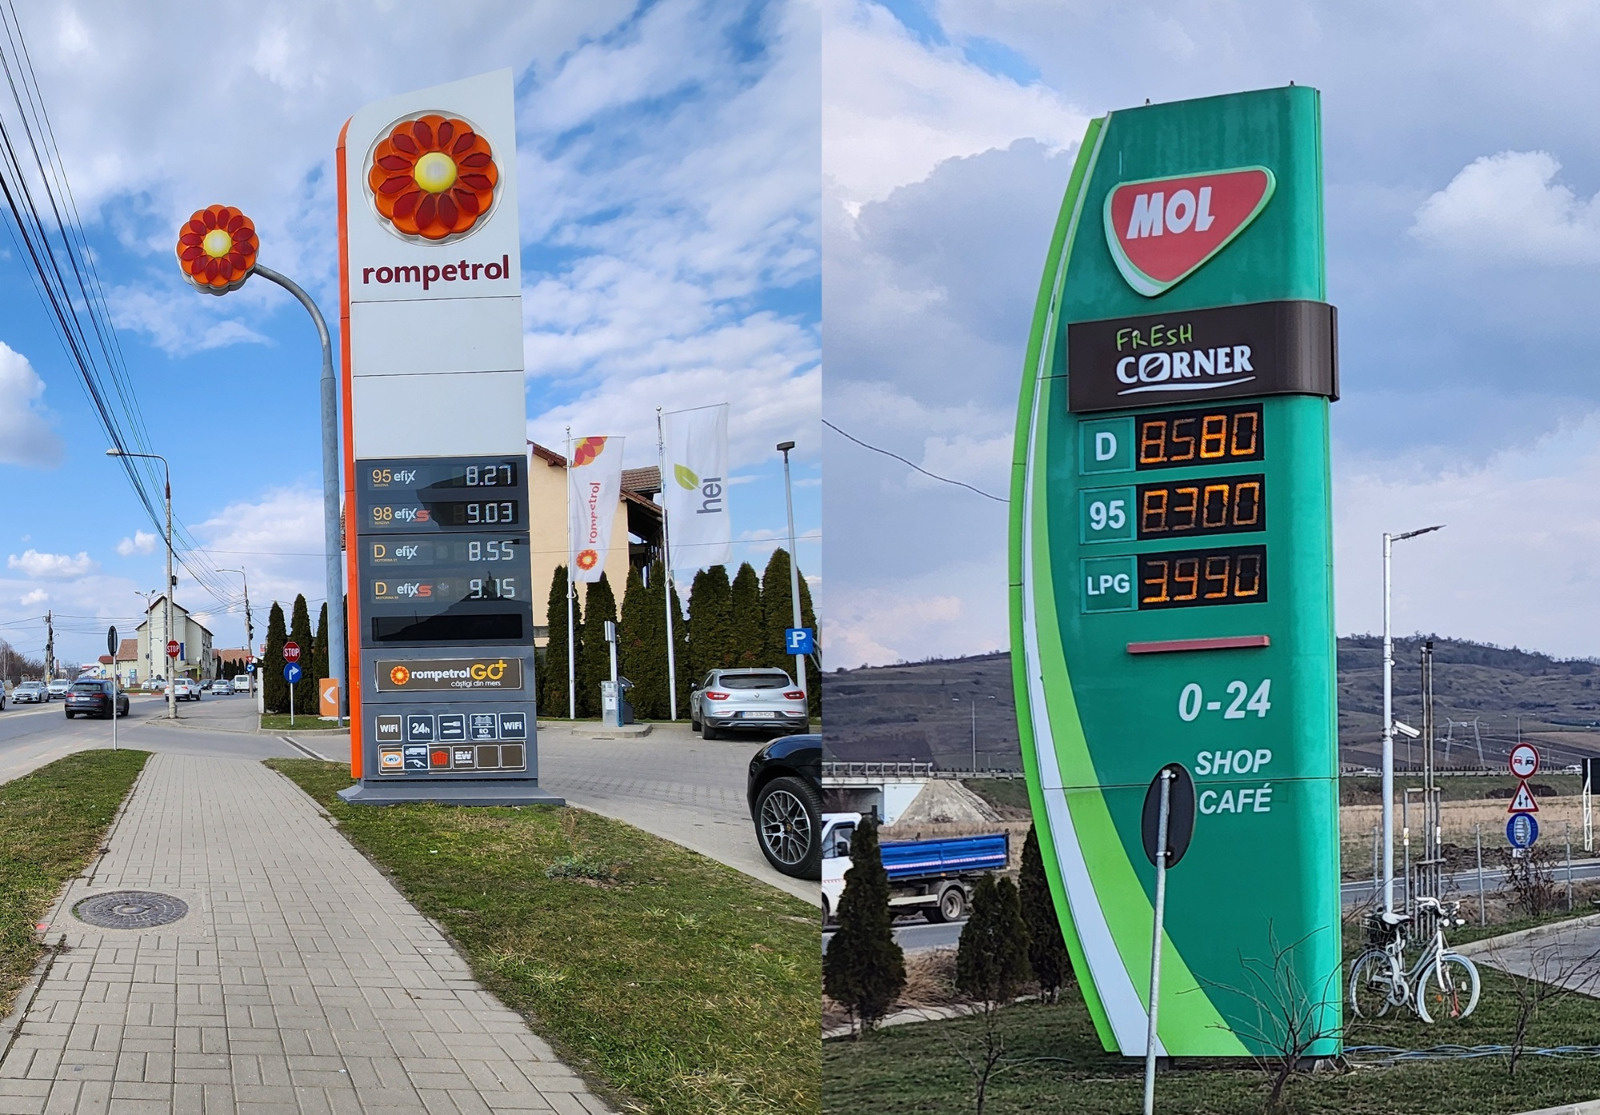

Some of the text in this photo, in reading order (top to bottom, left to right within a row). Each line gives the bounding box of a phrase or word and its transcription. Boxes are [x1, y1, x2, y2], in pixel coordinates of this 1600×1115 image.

[1126, 186, 1216, 240] MOL
[362, 254, 510, 291] rompetrol
[1116, 345, 1254, 384] CORNER
[1094, 431, 1118, 462] D
[372, 464, 512, 487] 95 efix 8.27
[373, 506, 393, 521] 98
[467, 502, 513, 524] 9.03
[588, 481, 602, 545] rompetrol
[1089, 499, 1127, 531] 95
[374, 540, 515, 562] D efix 8.55
[375, 582, 387, 595] D
[469, 577, 516, 599] 9.15
[1087, 573, 1131, 596] LPG
[166, 645, 180, 654] STOP
[789, 630, 807, 648] P
[284, 647, 300, 657] STOP
[411, 722, 431, 734] 24h
[1194, 748, 1273, 776] SHOP
[1198, 782, 1273, 815] CAFÉ
